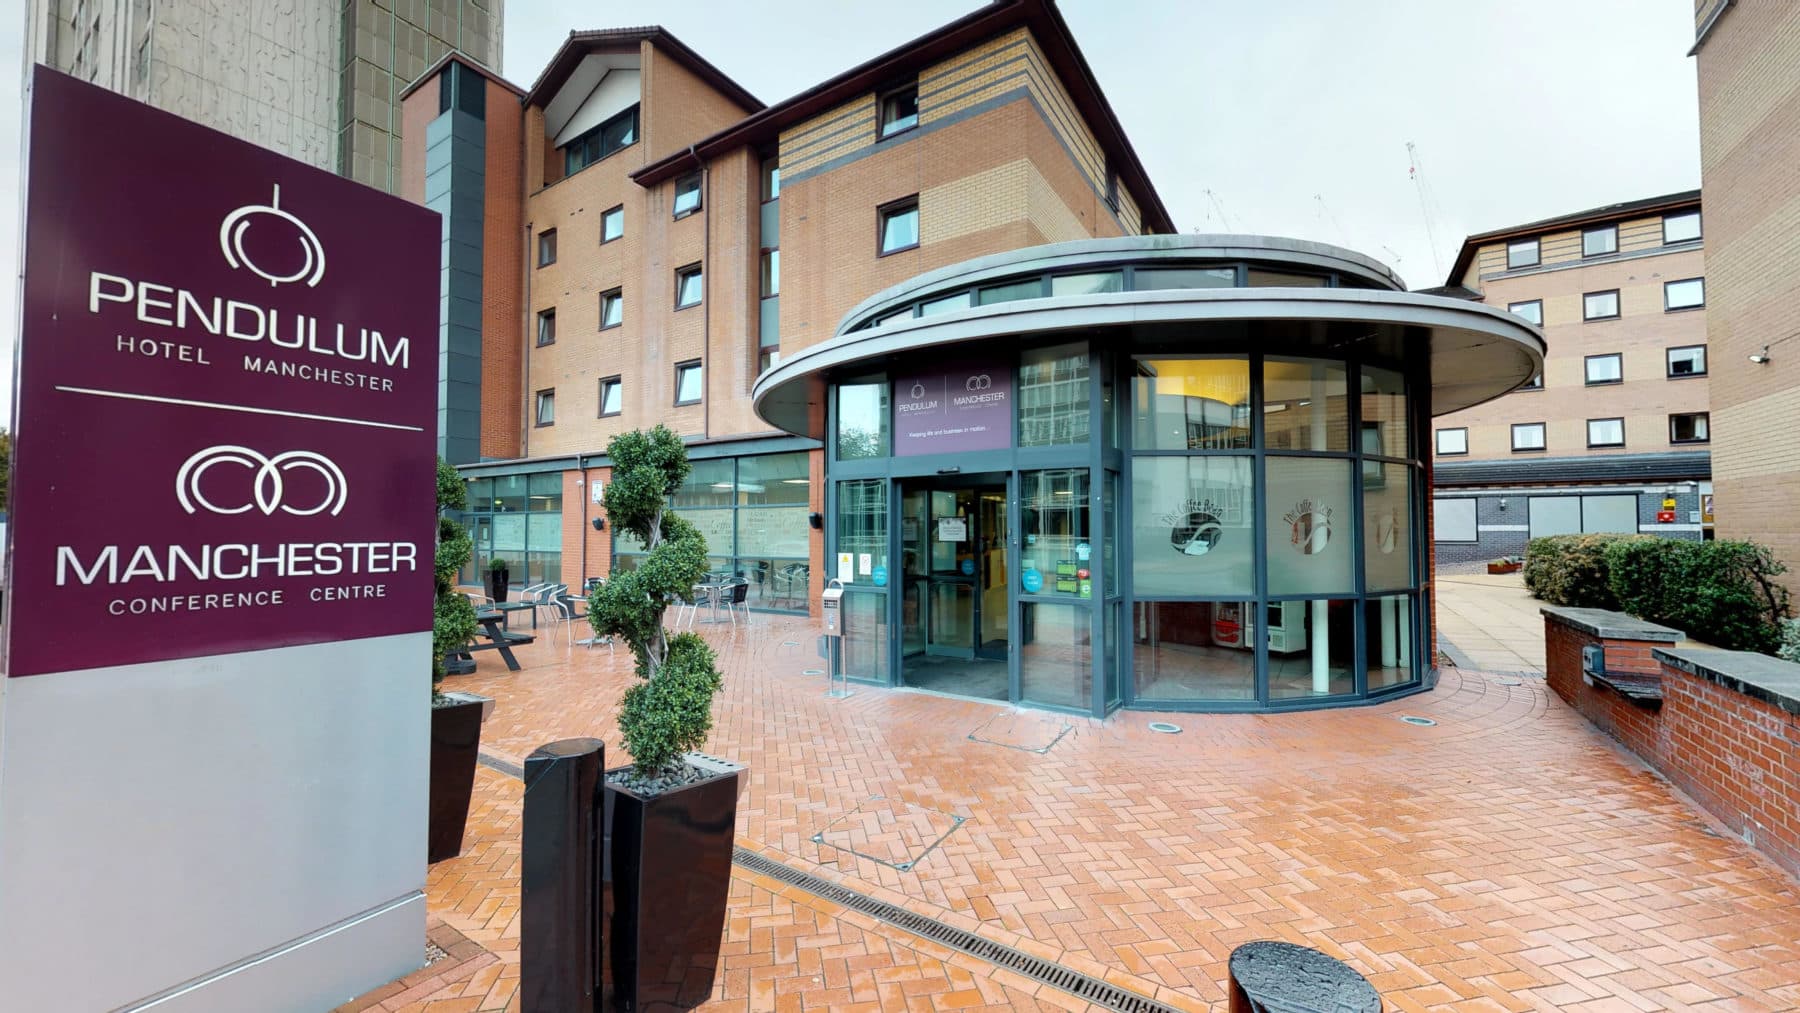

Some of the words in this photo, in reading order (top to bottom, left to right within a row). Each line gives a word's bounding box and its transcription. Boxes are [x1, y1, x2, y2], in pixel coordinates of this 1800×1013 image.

[89, 271, 409, 369] PENDULUM
[117, 334, 211, 365] HOTEL
[244, 355, 394, 392] MANCHESTER
[899, 401, 938, 412] PENDULUM
[953, 392, 1005, 405] MANCHESTER
[1178, 498, 1203, 514] Coffee
[56, 542, 417, 586] MANCHESTER
[109, 590, 284, 615] CONFERENCE
[310, 584, 386, 602] CENTRE
